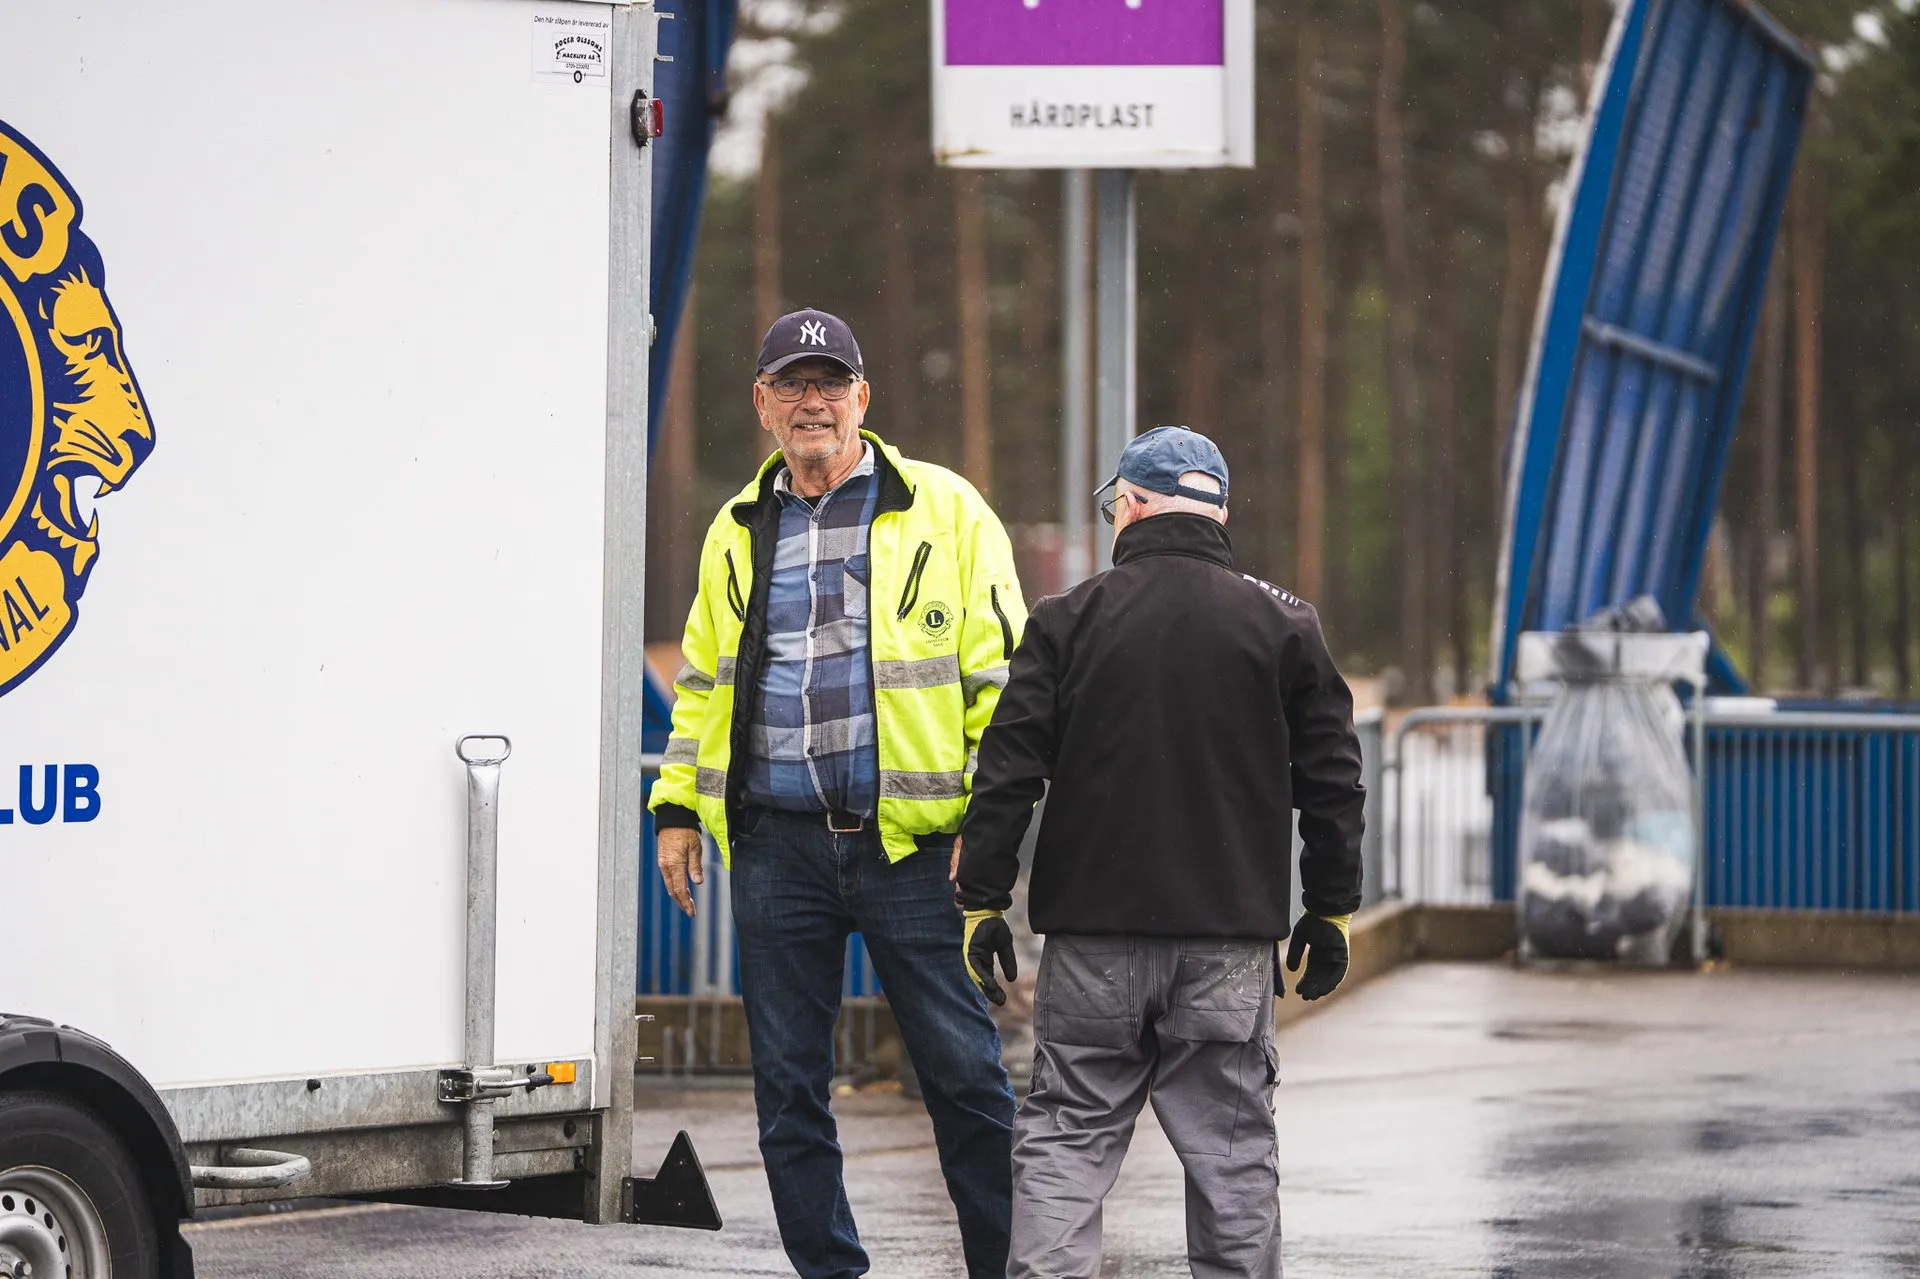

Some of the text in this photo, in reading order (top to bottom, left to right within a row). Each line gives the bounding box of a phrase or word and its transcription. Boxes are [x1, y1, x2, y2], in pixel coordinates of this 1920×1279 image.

[534, 15, 544, 23] Den
[554, 36, 602, 52] ROGER OLSSONS
[1010, 99, 1155, 128] HÅRDPLAST
[0, 152, 58, 259] S
[800, 320, 827, 346] NY
[929, 612, 941, 626] L
